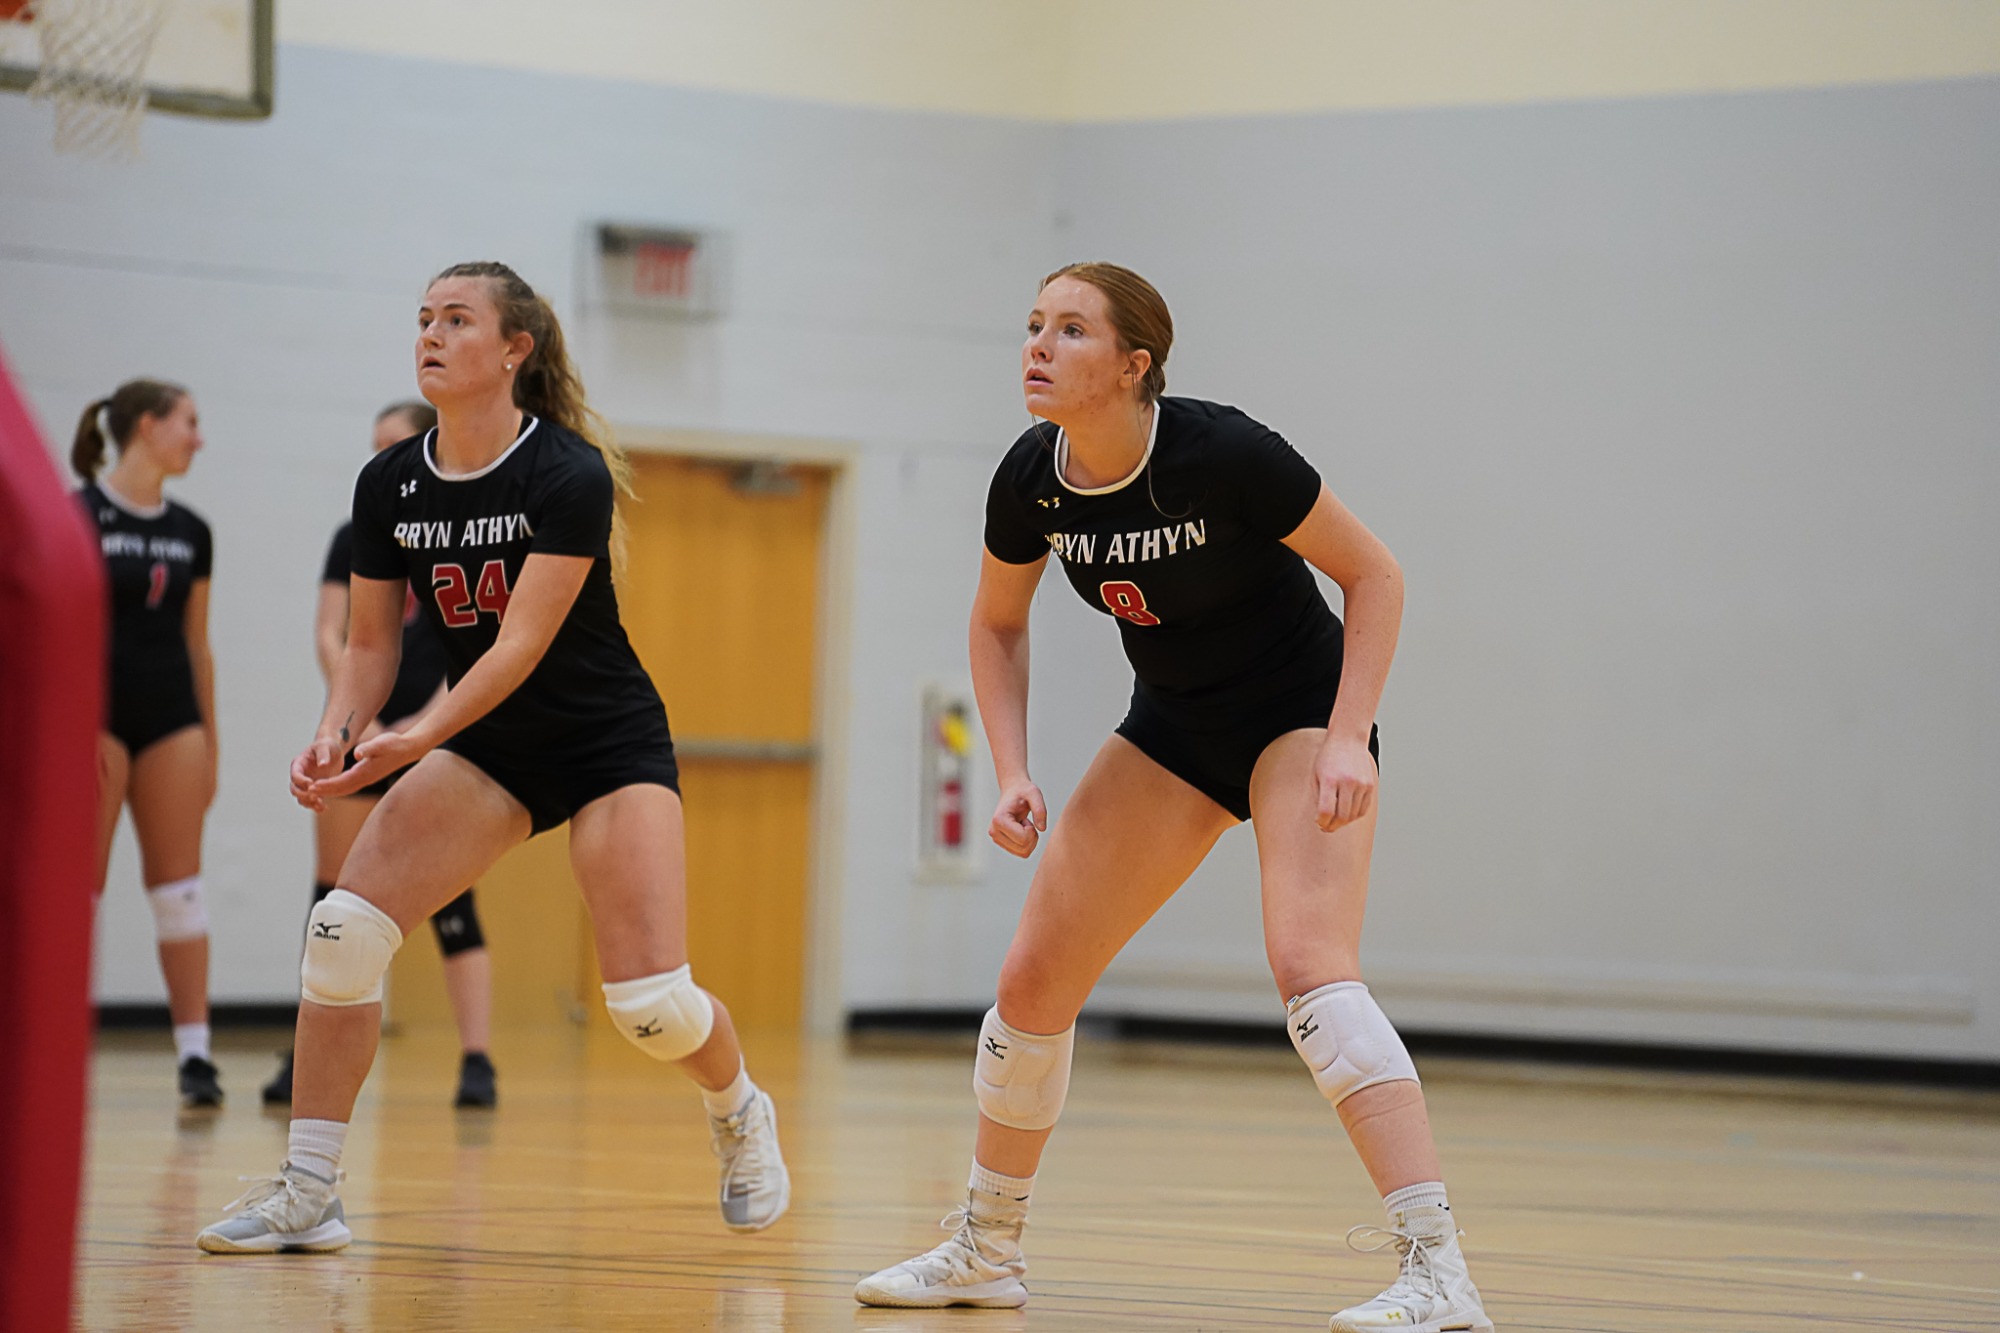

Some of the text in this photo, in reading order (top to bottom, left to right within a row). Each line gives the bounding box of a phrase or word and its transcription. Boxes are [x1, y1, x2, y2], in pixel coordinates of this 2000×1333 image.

[393, 520, 452, 549] BRYN
[1045, 518, 1206, 564] RYN ATHYN
[432, 559, 512, 628] 24
[1100, 580, 1161, 626] 8
